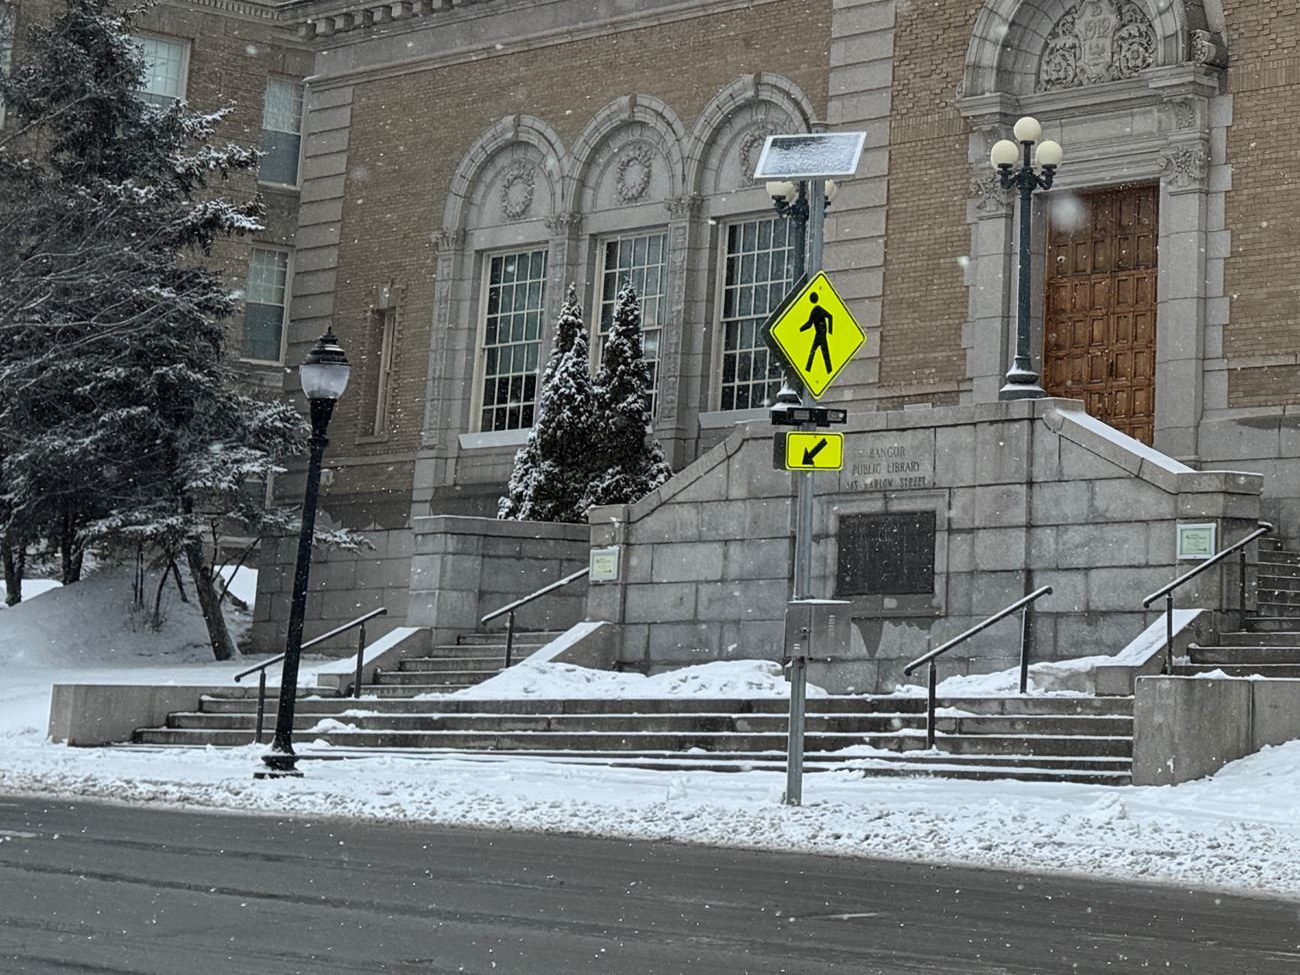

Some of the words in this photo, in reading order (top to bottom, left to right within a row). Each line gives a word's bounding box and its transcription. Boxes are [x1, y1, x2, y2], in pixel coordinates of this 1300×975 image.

[869, 445, 906, 458] BANGOR
[852, 463, 882, 476] PUBLIC
[887, 461, 920, 473] LIBRARY
[900, 476, 926, 488] STREET
